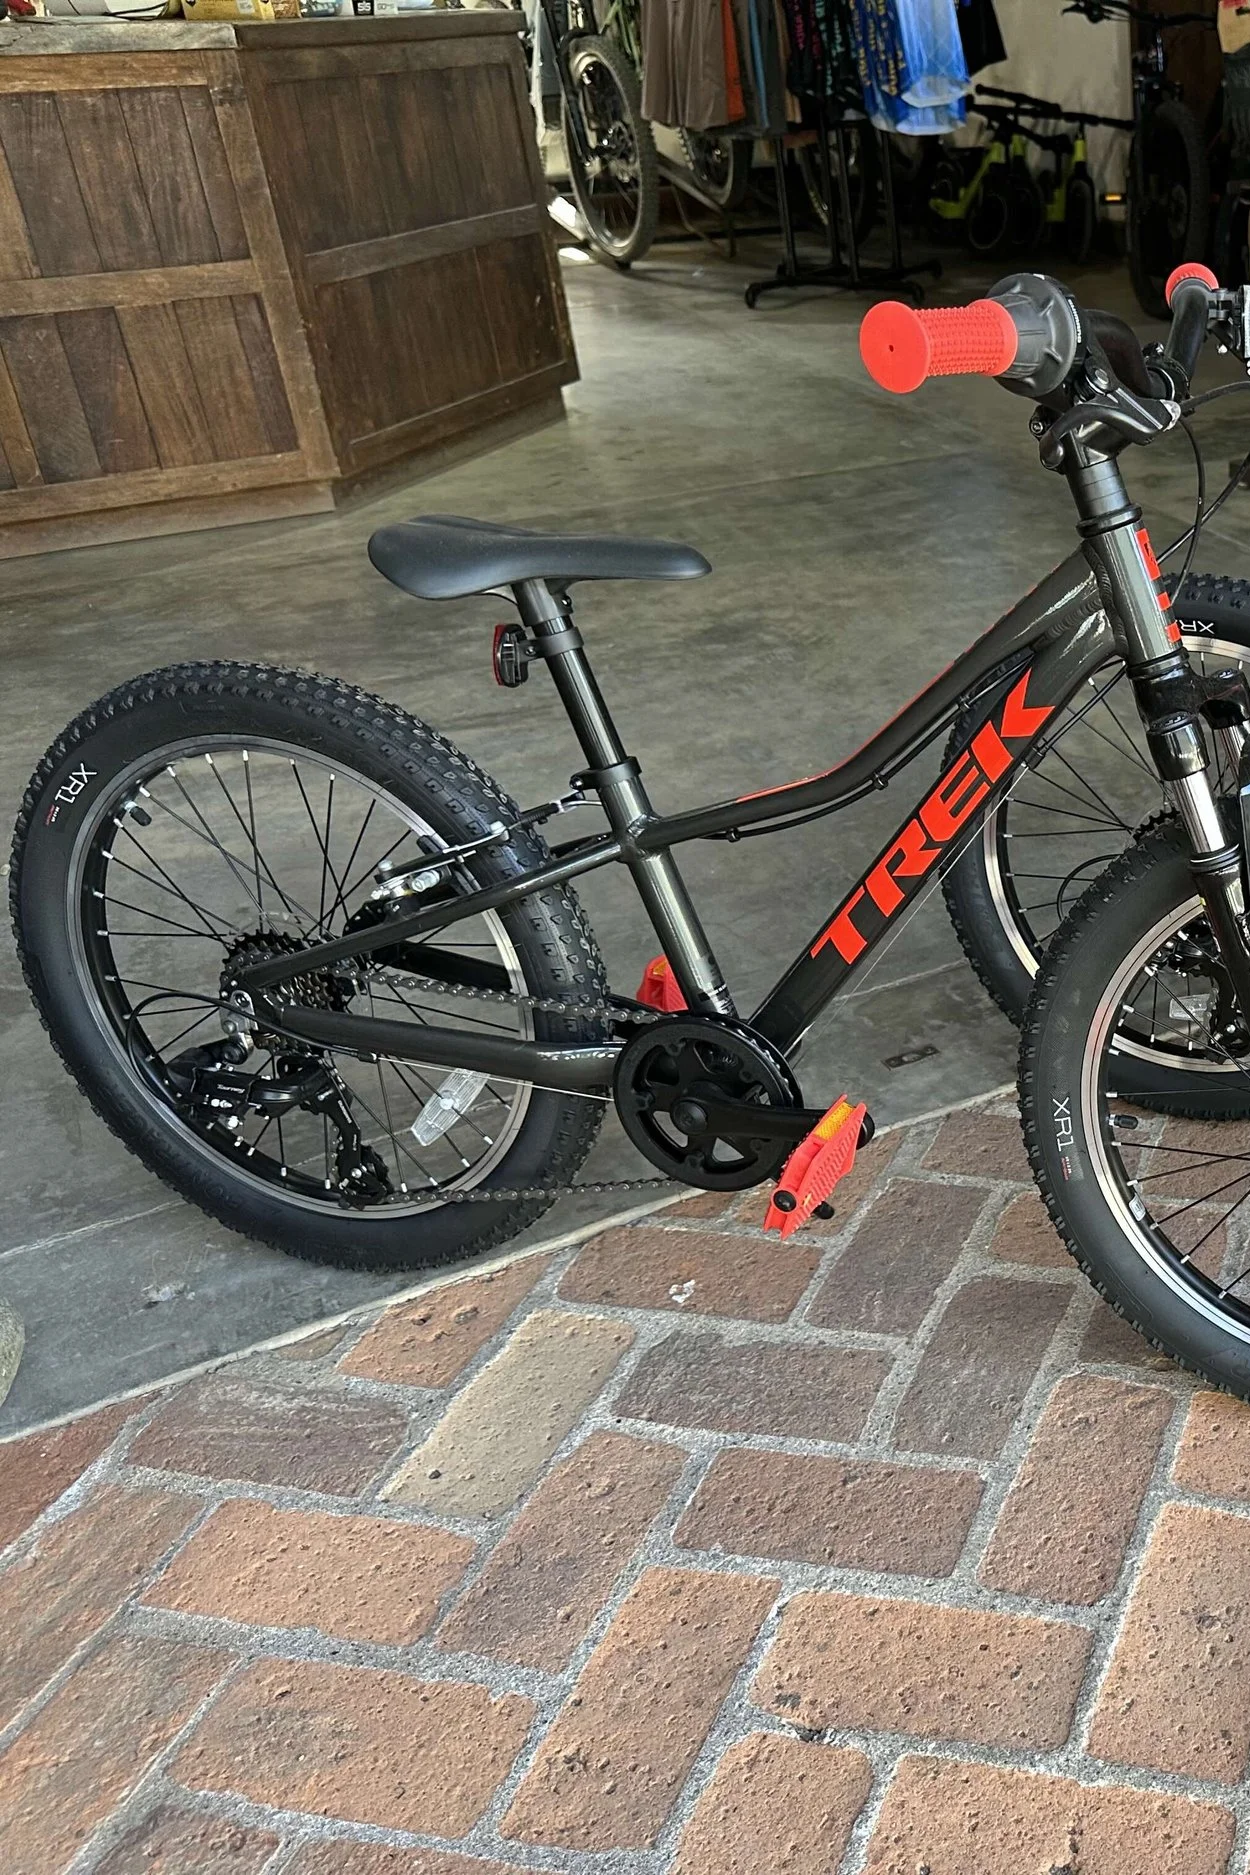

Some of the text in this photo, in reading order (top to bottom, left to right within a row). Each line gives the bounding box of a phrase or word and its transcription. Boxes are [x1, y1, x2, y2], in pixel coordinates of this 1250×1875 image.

[1174, 619, 1215, 635] XR
[54, 762, 98, 804] XR1
[810, 667, 1055, 965] TREK
[1052, 1096, 1074, 1152] XR1
